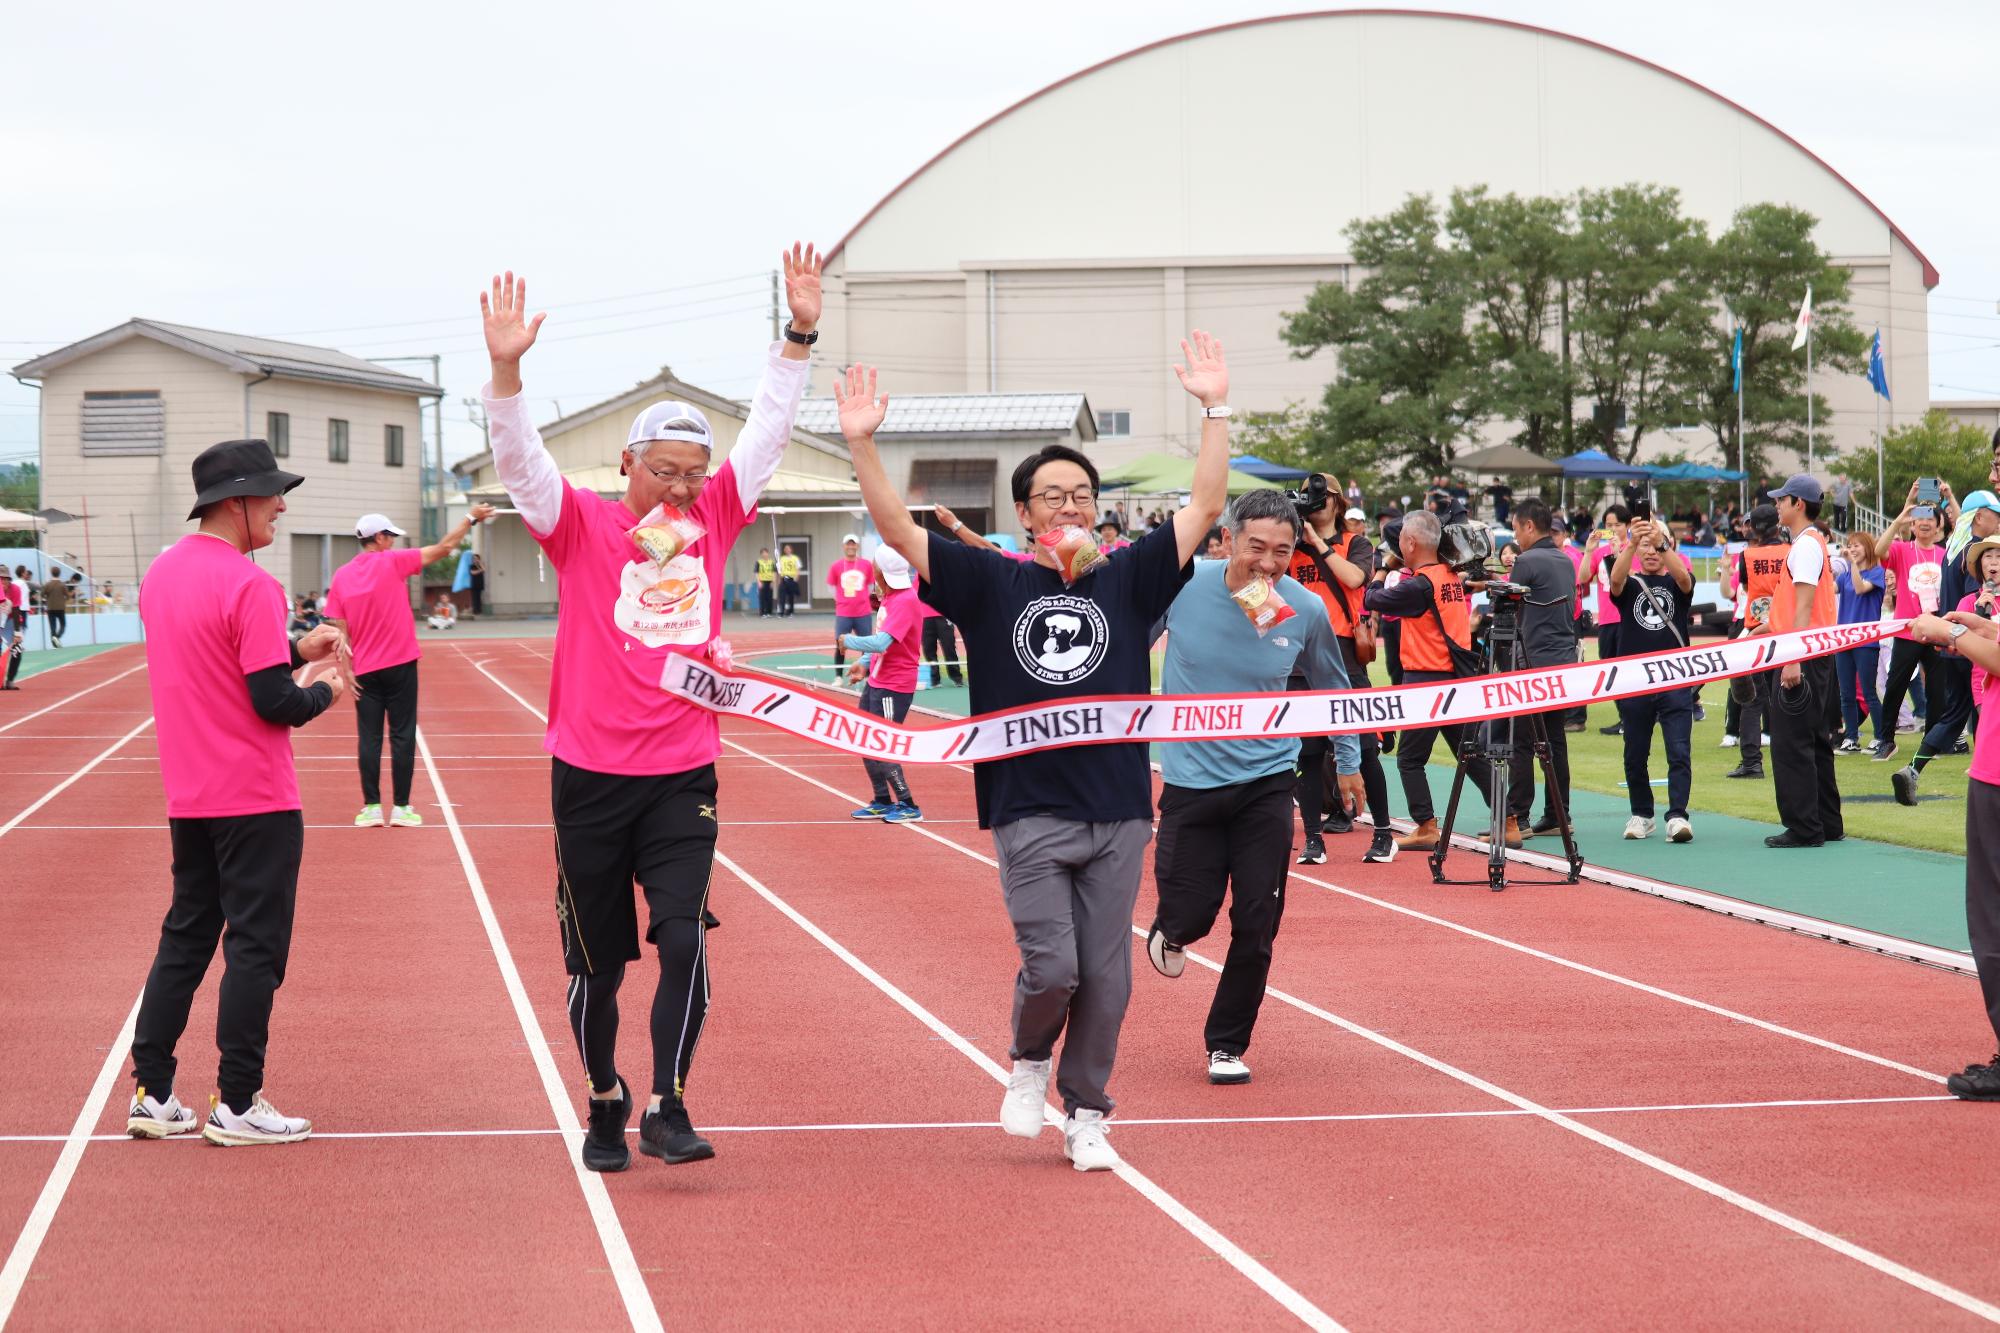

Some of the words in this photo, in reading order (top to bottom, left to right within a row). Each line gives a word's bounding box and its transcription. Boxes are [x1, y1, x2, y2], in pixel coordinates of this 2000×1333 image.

[1296, 565, 1325, 584] 報
[1753, 559, 1784, 576] 報道
[1441, 582, 1463, 604] 報道
[1036, 667, 1064, 681] SINCE
[1067, 665, 1088, 680] 2024
[681, 664, 746, 707] FINISH
[807, 707, 914, 756] FINISH
[1004, 707, 1103, 747] FINISH
[1171, 704, 1243, 731] FINISH
[1329, 695, 1405, 724] FINISH
[1481, 675, 1568, 709] FINISH
[1642, 651, 1729, 684] FINISH
